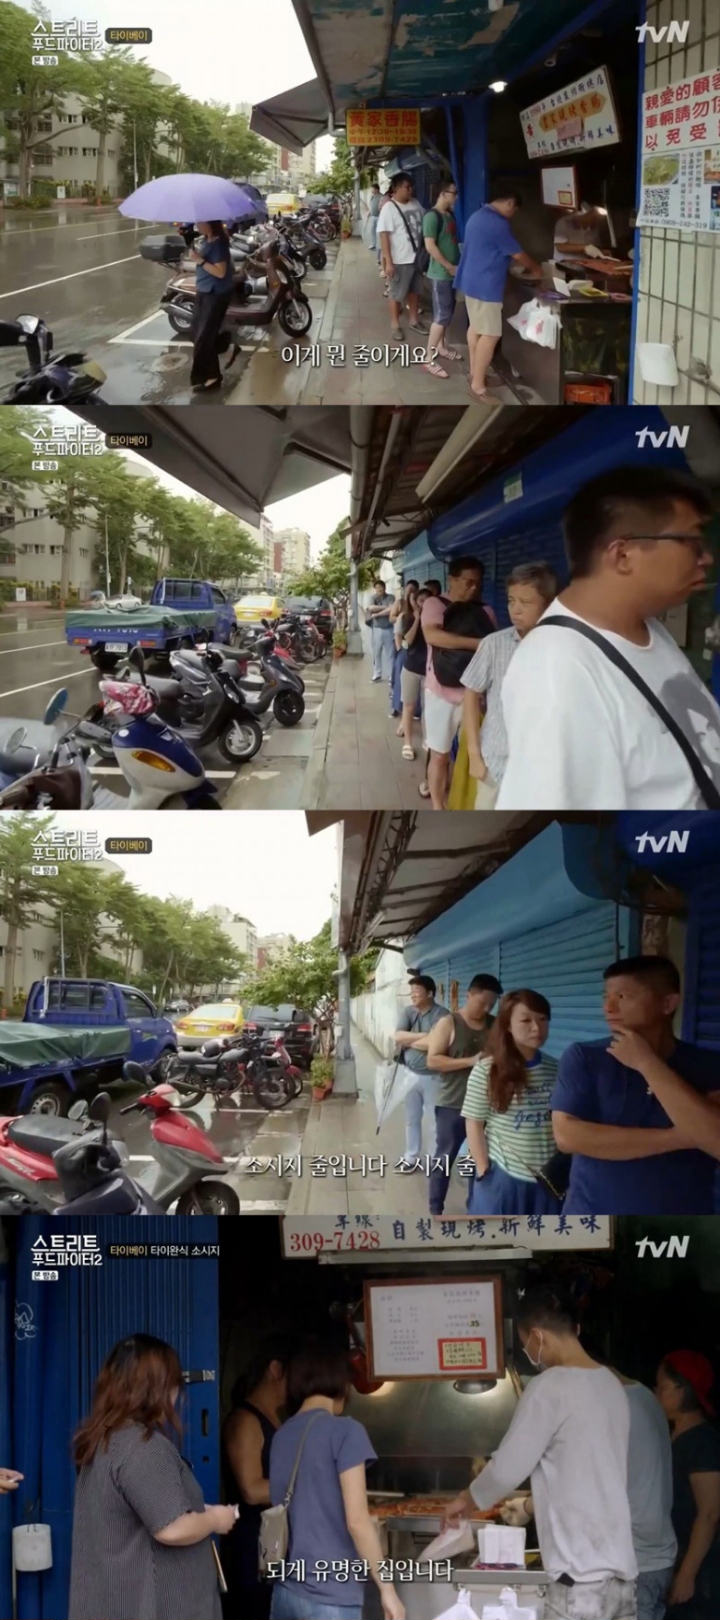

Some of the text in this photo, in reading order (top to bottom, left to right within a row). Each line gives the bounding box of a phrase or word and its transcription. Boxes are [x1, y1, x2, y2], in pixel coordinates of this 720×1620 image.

[645, 73, 720, 111] 親愛的顧客
[349, 111, 417, 127] 黃家香腸
[645, 120, 720, 149] 以免受
[291, 1231, 380, 1252] 309-7428
